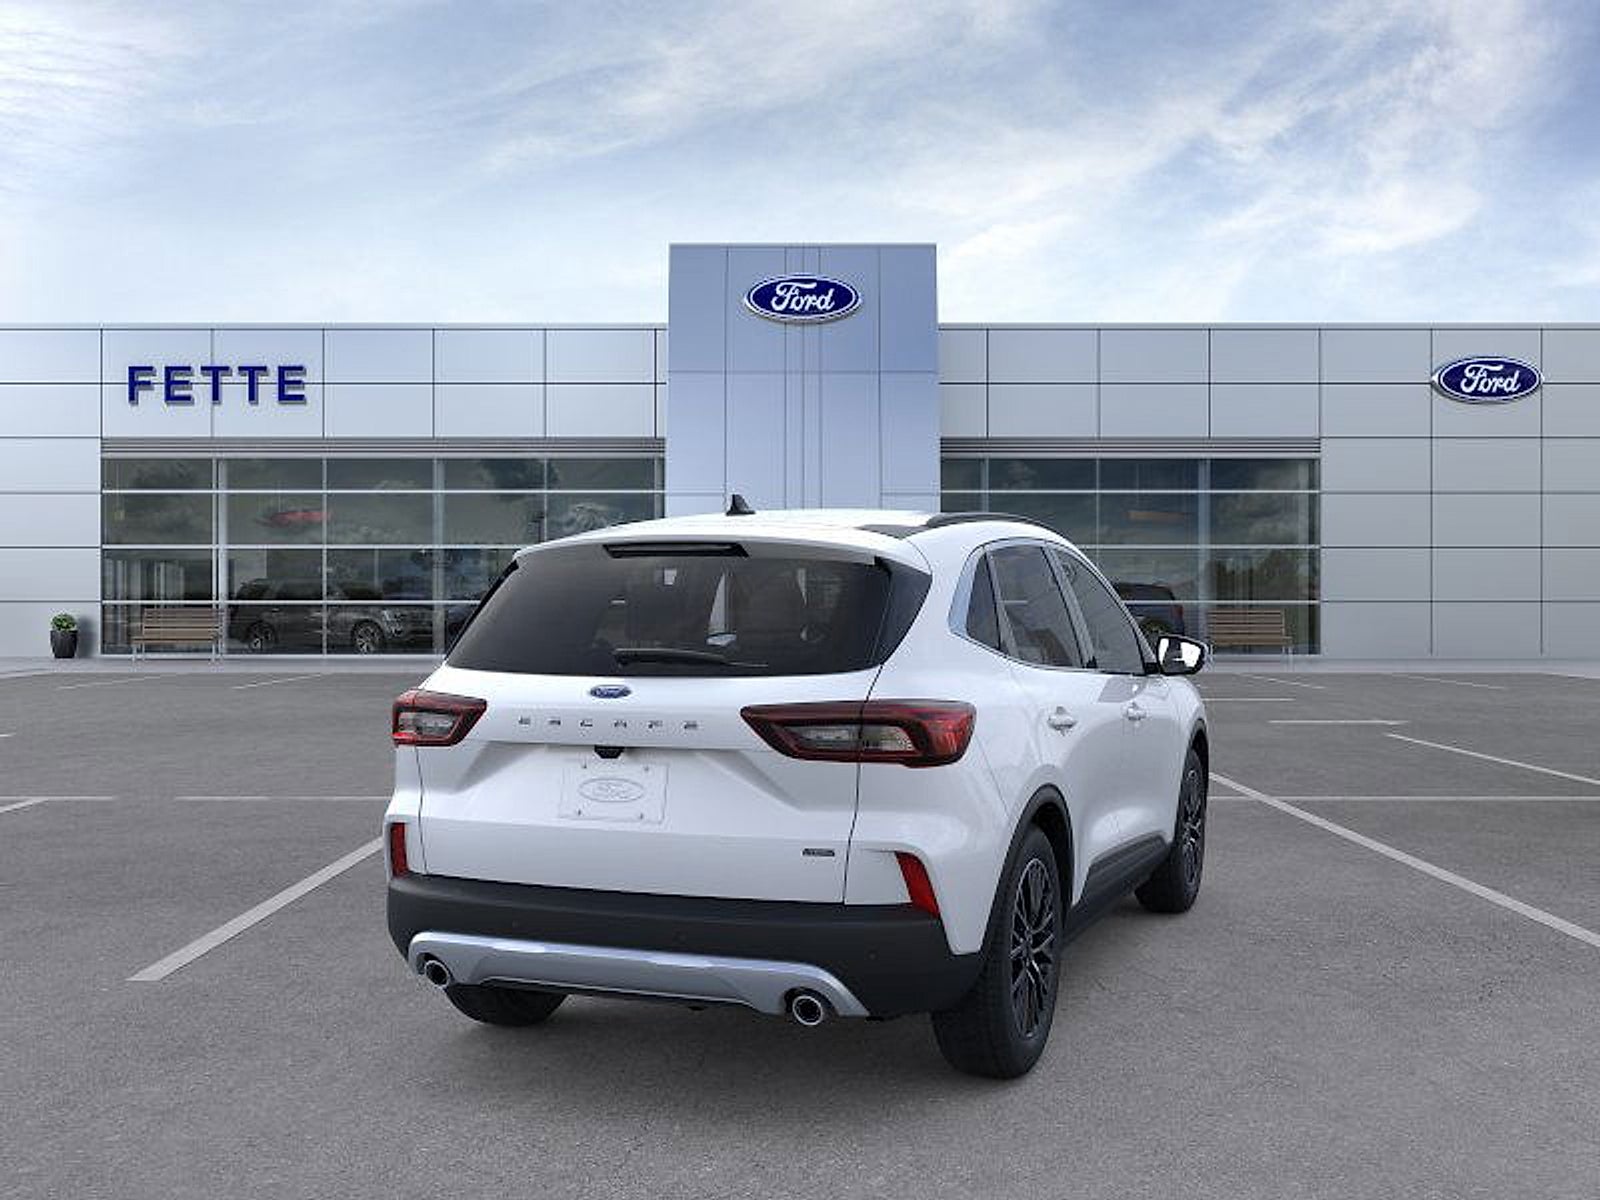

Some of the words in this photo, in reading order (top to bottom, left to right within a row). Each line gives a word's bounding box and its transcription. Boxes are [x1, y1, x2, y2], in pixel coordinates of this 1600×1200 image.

[771, 282, 835, 311] Ford
[128, 366, 306, 405] FETTE
[1461, 364, 1520, 393] Ford
